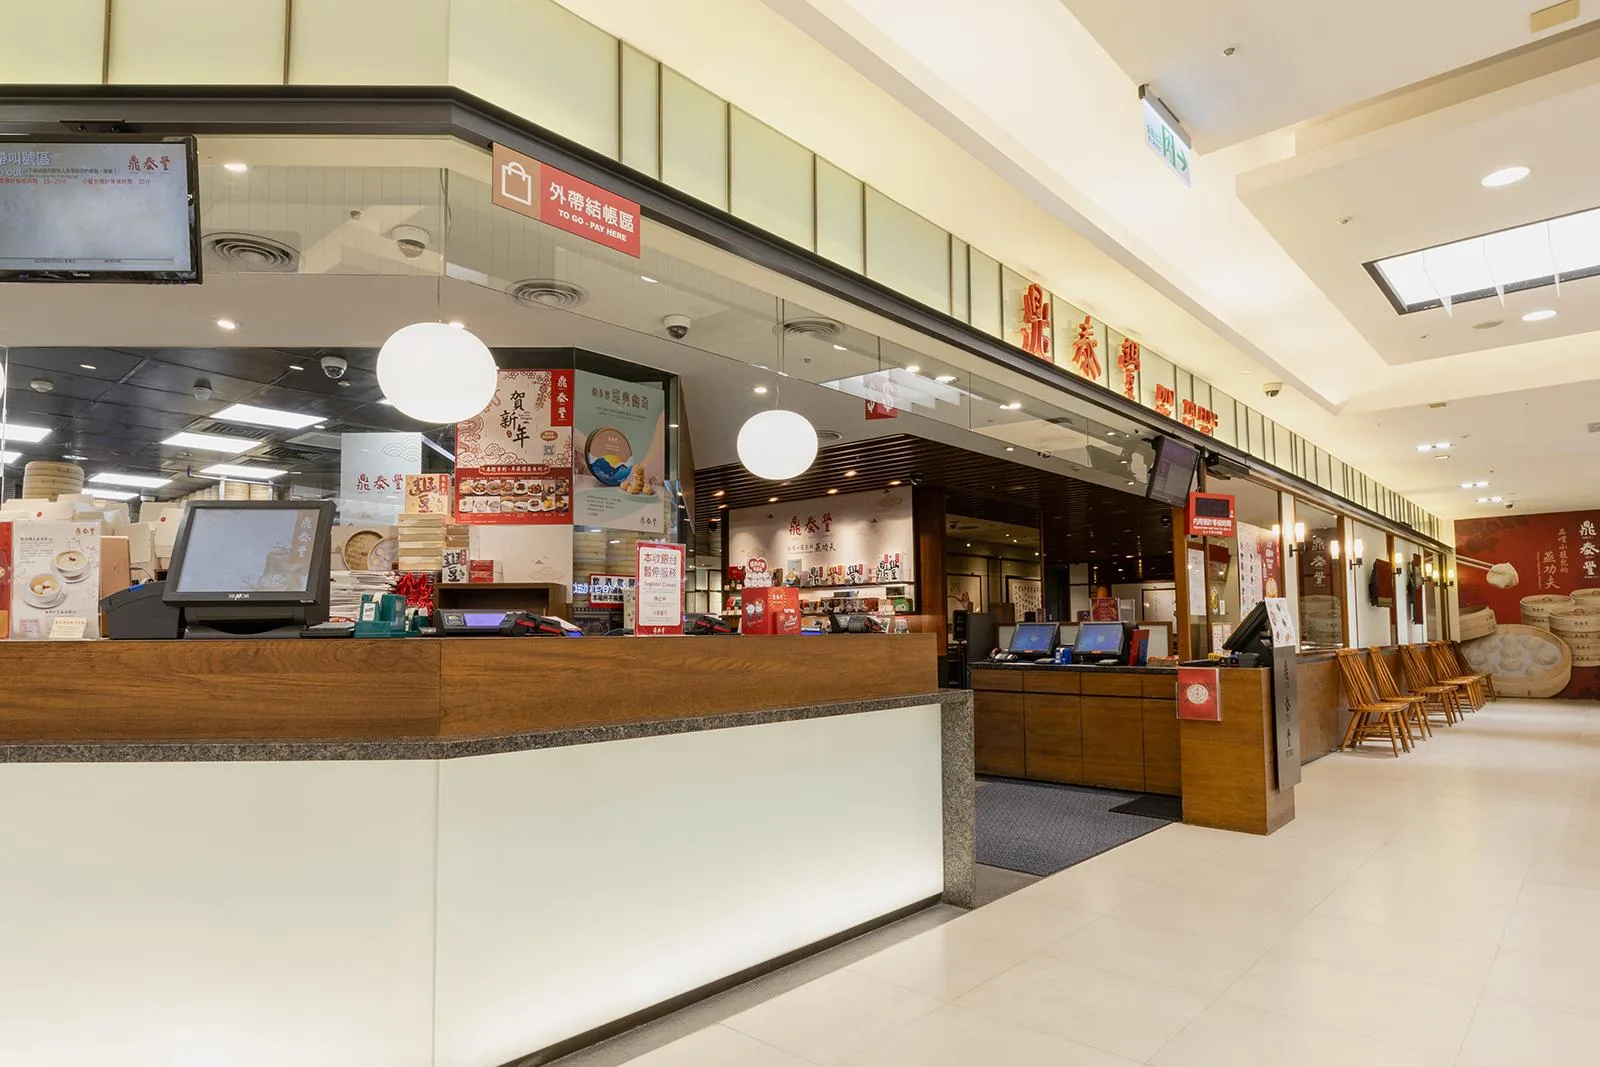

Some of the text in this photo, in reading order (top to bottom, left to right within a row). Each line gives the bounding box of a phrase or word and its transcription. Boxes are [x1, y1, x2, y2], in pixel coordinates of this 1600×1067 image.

[549, 182, 634, 233] 外帶結帳區
[558, 208, 570, 220] TO
[572, 214, 584, 225] GO
[590, 221, 605, 233] PAY
[606, 228, 627, 242] HERE
[1020, 282, 1141, 401] 鼎泰豐
[356, 473, 404, 492] 鼎泰豐
[644, 552, 677, 565] 本收銀台
[1579, 520, 1599, 575] 鼎泰豐
[643, 566, 677, 578] 暫停服務
[1543, 550, 1560, 590] 蒸功夫
